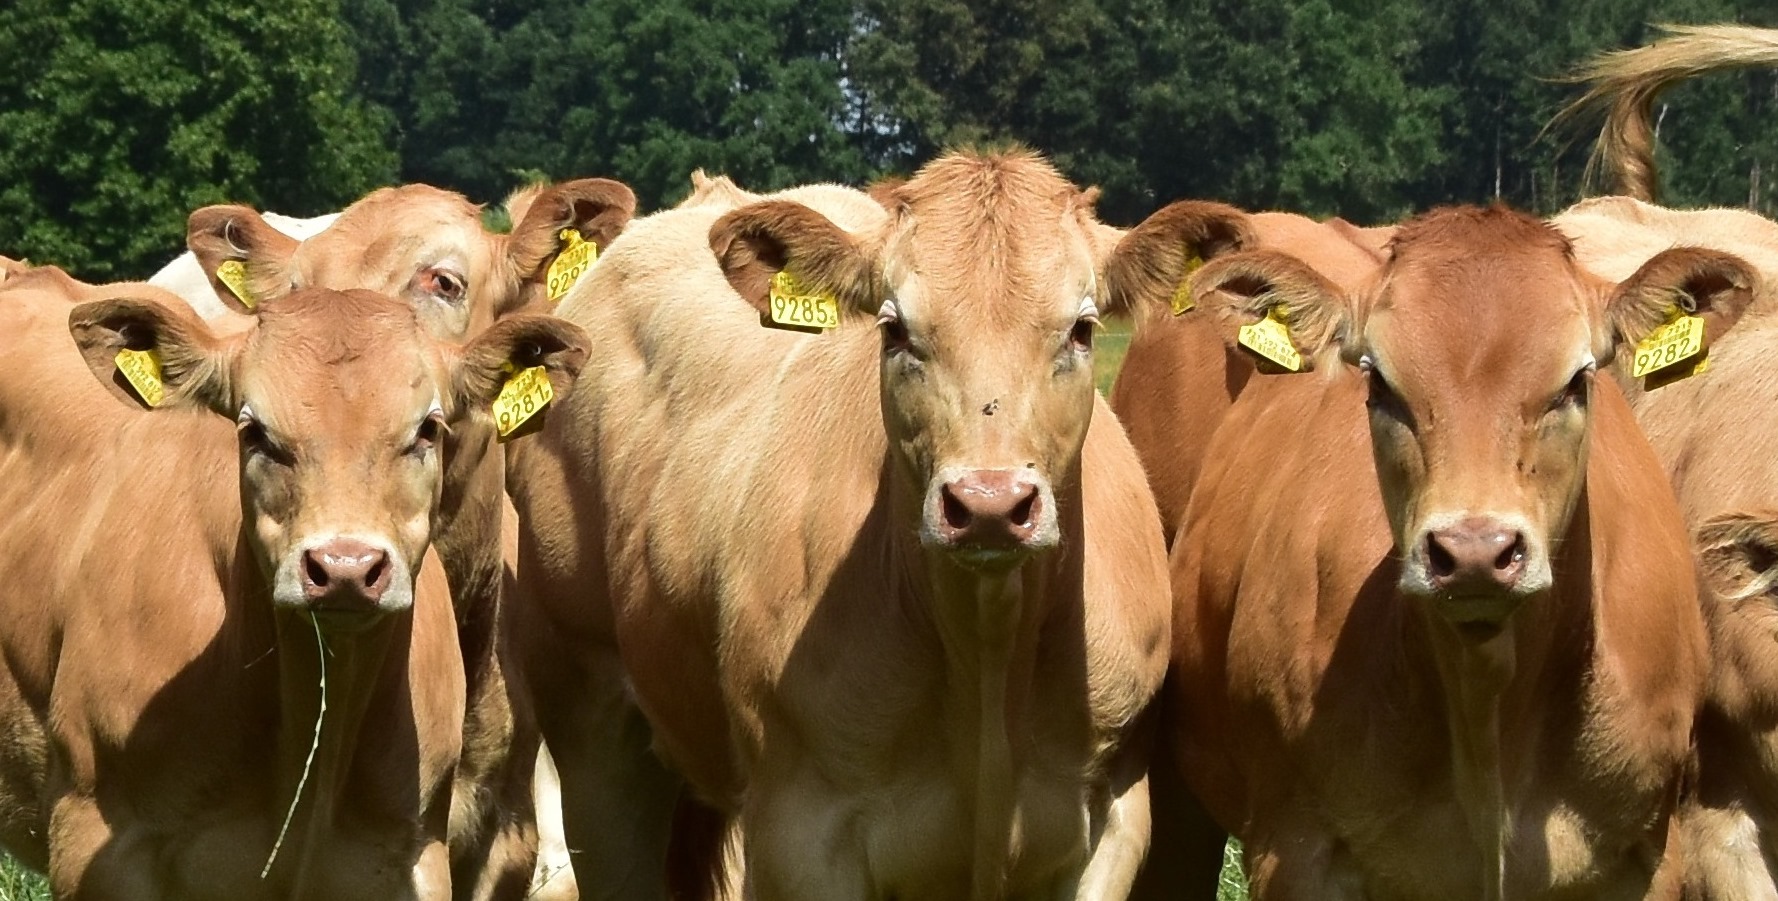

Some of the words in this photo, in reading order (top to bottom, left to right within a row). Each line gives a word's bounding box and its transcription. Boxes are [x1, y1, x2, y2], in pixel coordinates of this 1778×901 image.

[775, 295, 828, 324] 9285
[1637, 337, 1690, 375] 9282
[500, 384, 545, 431] 9281
